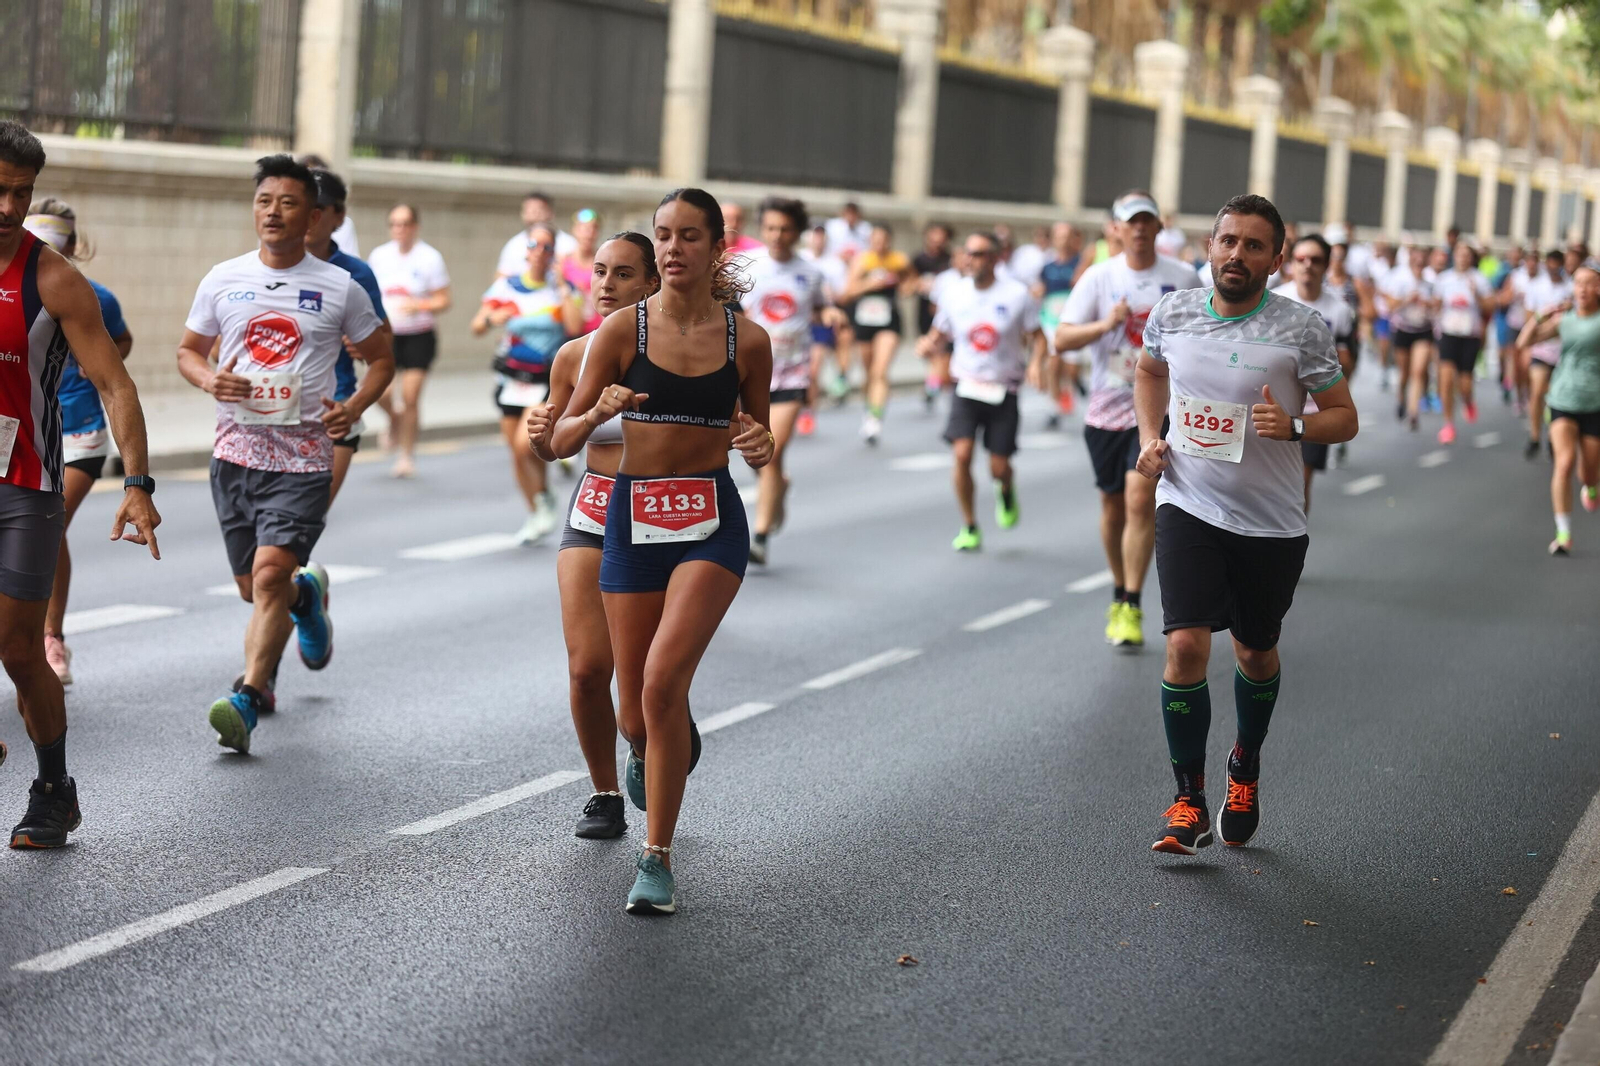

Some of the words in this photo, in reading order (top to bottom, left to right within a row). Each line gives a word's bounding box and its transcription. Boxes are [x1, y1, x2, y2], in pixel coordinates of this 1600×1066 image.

[250, 334, 290, 356] FRENO
[254, 324, 297, 347] PONLE
[0, 351, 20, 364] aén
[1243, 363, 1268, 373] Running
[243, 386, 292, 400] 219
[651, 414, 705, 424] ARMOUR
[1183, 411, 1235, 434] 1292
[583, 488, 608, 507] 23
[643, 493, 706, 513] 2133
